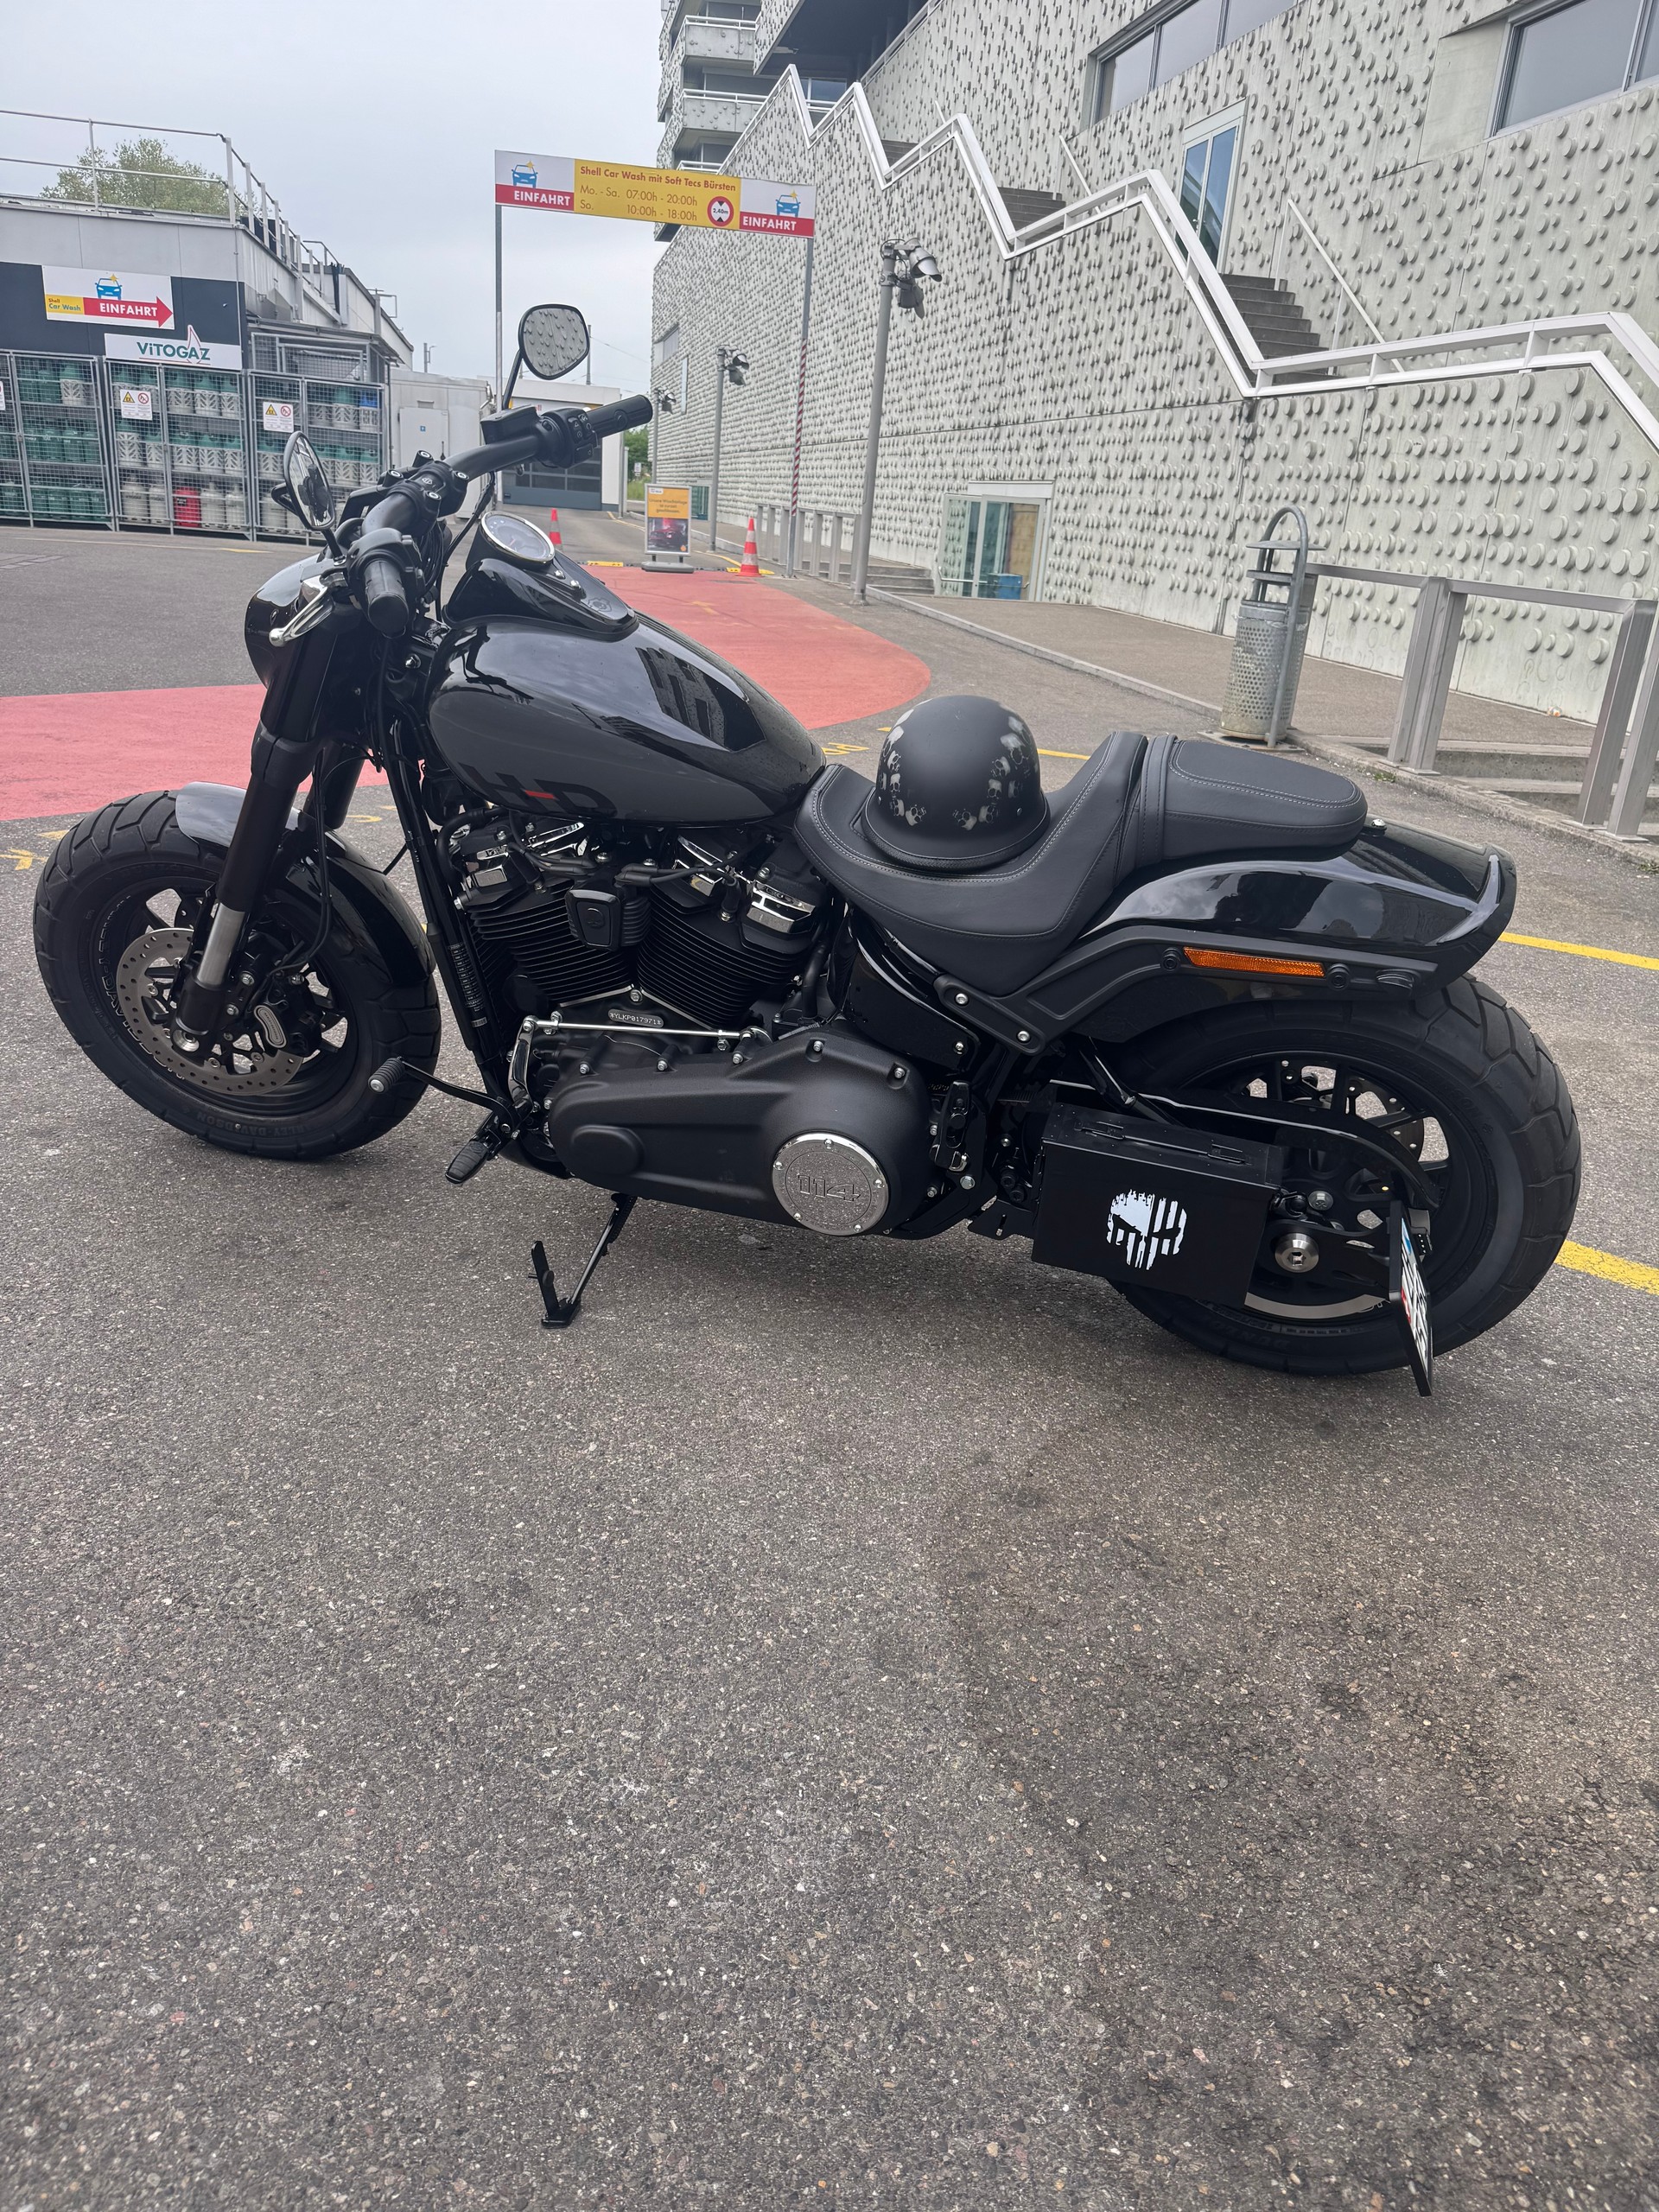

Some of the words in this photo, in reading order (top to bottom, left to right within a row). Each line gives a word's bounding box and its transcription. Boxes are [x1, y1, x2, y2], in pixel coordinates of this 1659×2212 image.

[581, 166, 601, 176] Shell
[604, 168, 620, 178] Car
[621, 171, 646, 181] Wash
[648, 175, 663, 183] mit
[664, 175, 682, 186] Soft
[684, 178, 702, 188] Tecs
[703, 180, 736, 191] Bürsten
[513, 190, 571, 207] EINFAHRT
[580, 185, 598, 195] Mo.
[606, 187, 620, 198] Sa.
[626, 188, 657, 202] 07:00h
[666, 194, 698, 207] 20:00h
[580, 199, 594, 210] So.
[626, 204, 657, 217] 10:00h
[667, 208, 697, 221] 18:00h
[742, 215, 798, 232] EINFAHRT
[99, 302, 158, 317] EINFAHRT
[798, 1175, 861, 1202] 114
